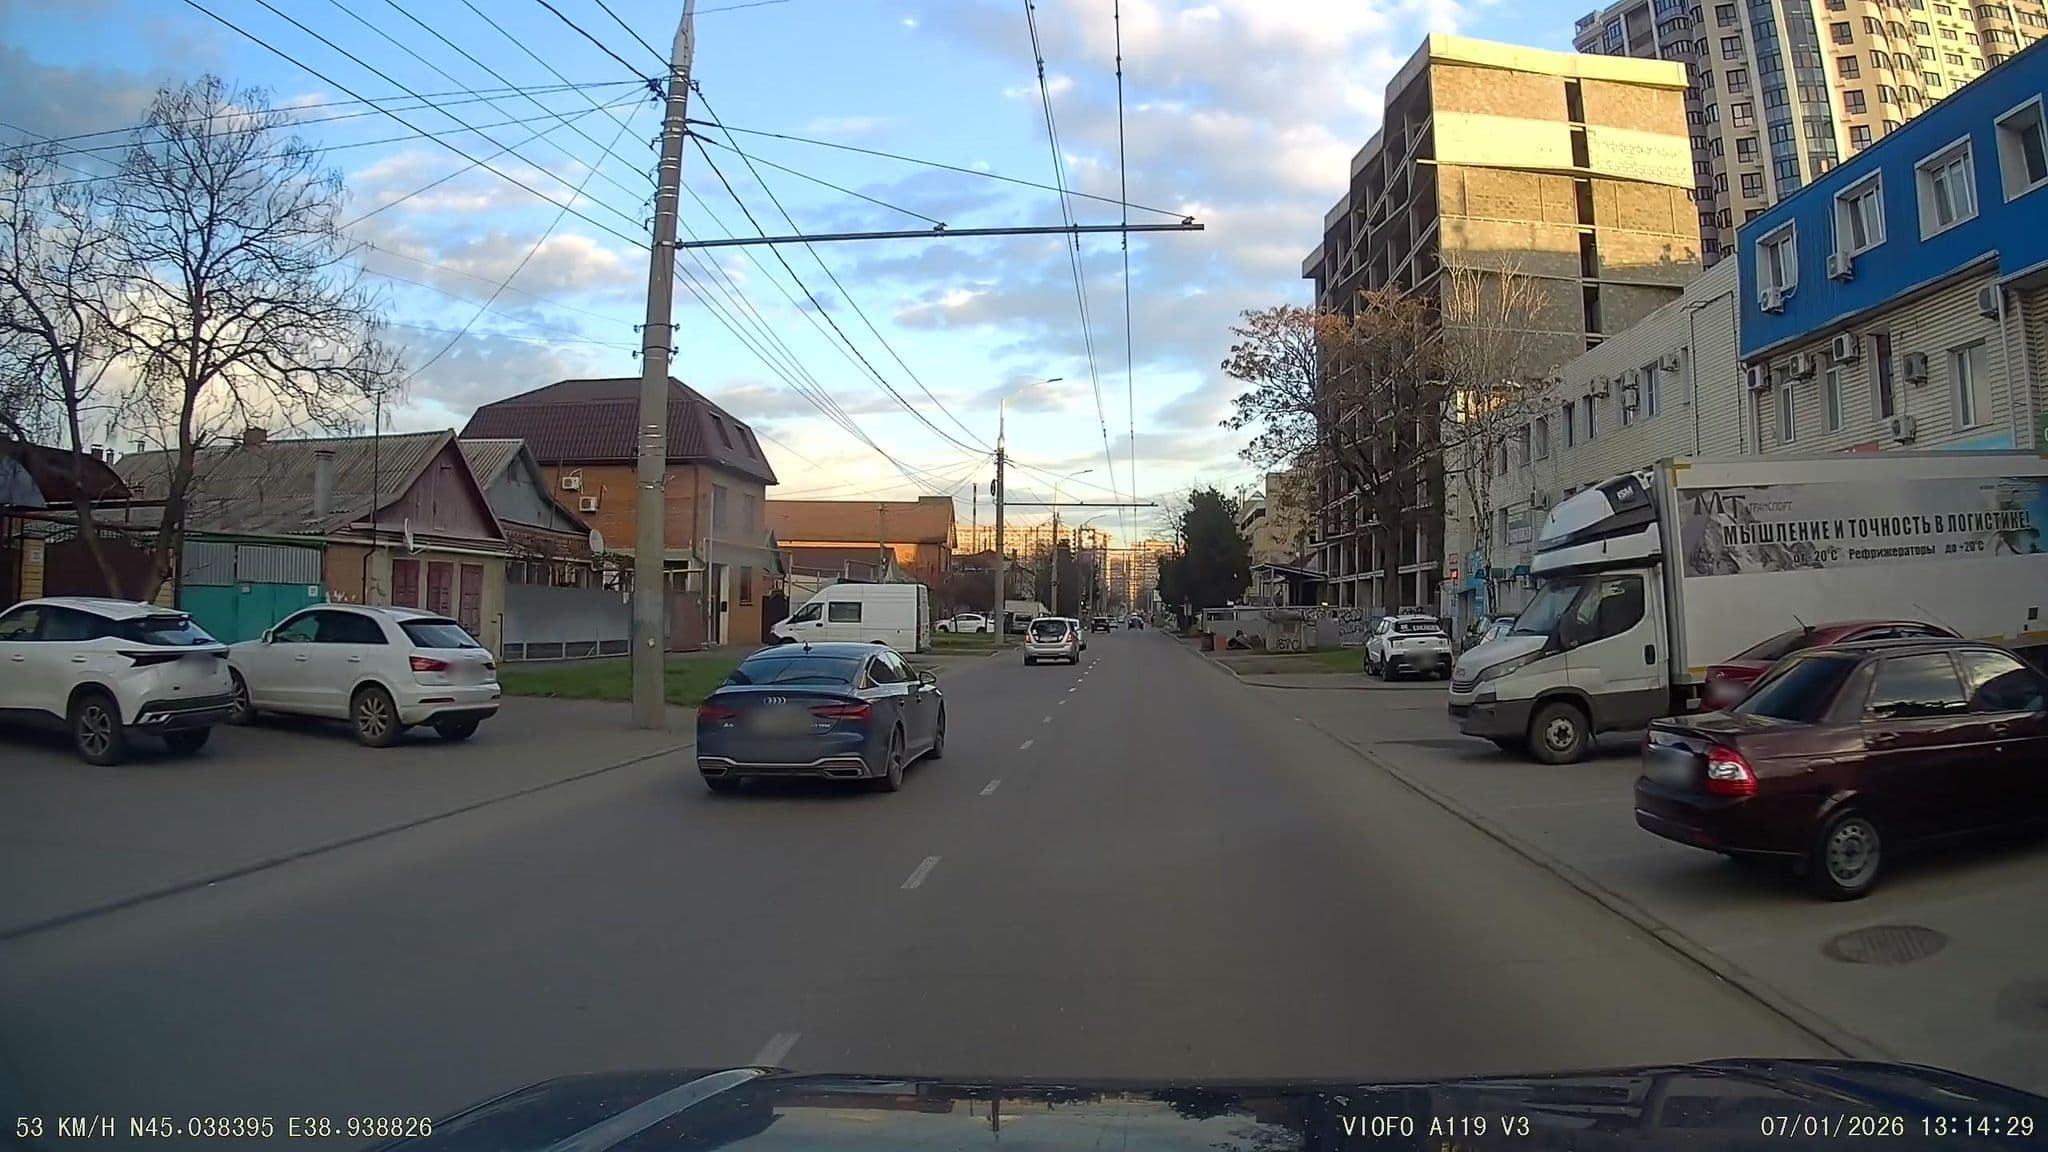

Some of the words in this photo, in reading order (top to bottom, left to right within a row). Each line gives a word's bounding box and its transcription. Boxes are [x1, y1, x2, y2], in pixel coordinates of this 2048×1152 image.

[1723, 520, 1830, 546] МЫШЛЕНИЕ
[1834, 519, 1845, 539] И
[1848, 515, 1931, 538] ТОЧНОСТЬ
[1935, 514, 1944, 534] В
[1948, 510, 2031, 533] ЛОГИСТИКЕ!
[1849, 544, 1936, 561] Рефрижераторы
[1945, 543, 1958, 554] до
